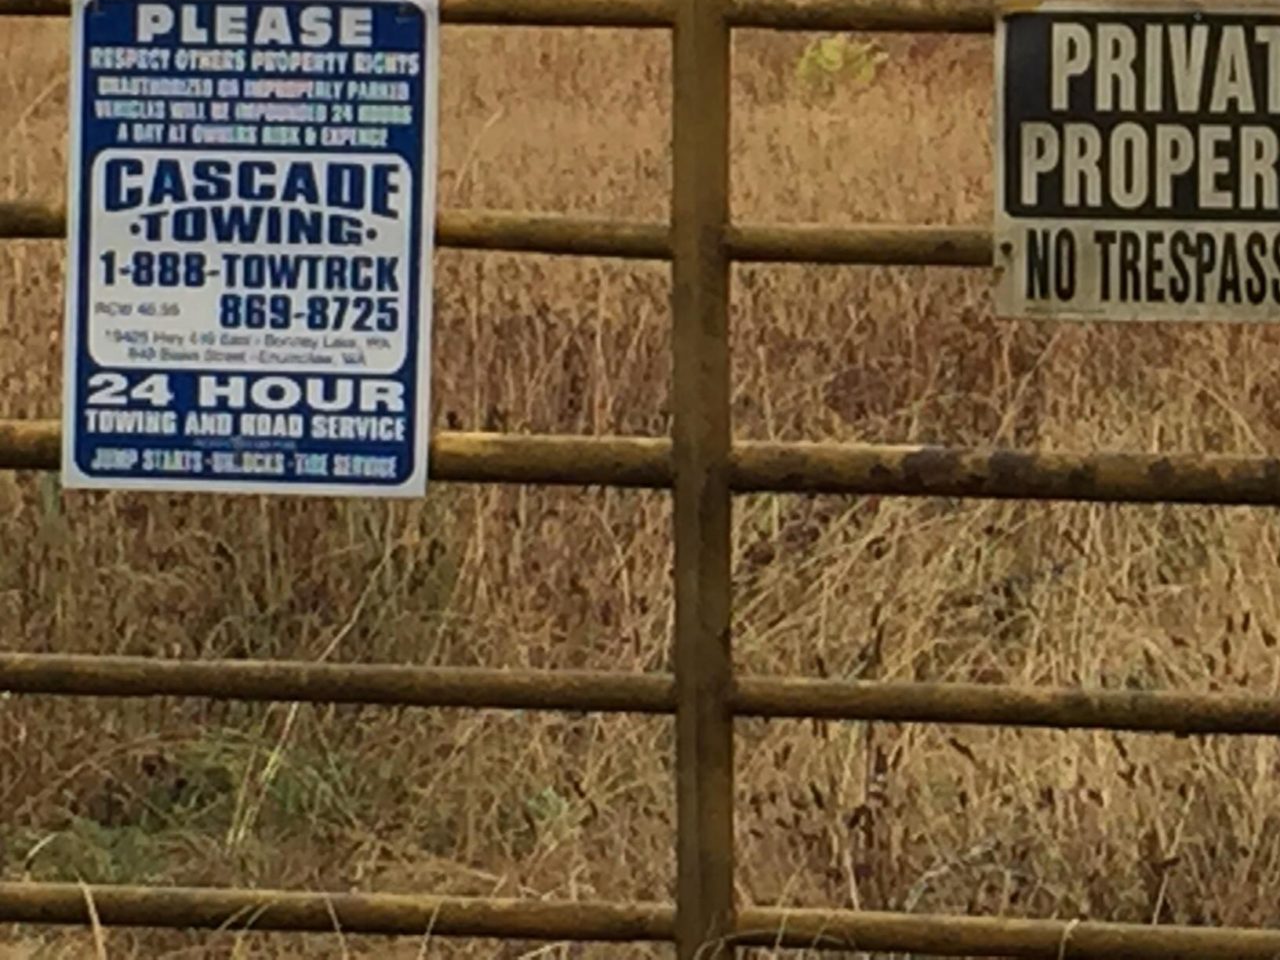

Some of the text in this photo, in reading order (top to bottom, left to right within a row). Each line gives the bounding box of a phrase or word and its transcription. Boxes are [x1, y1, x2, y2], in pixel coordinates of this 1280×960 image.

[136, 3, 373, 46] PLEASE
[90, 47, 420, 75] RESPECT OTHERS PROPERTY RIGHTS
[116, 123, 128, 142] A
[104, 158, 400, 220] CASCADE
[100, 250, 400, 291] 1-888-TOWTRCK
[1025, 227, 1076, 302] NO
[219, 294, 398, 333] 869-8725
[87, 373, 406, 412] 24 HOUR
[85, 409, 406, 441] TOWING AND ROAD SERVICE
